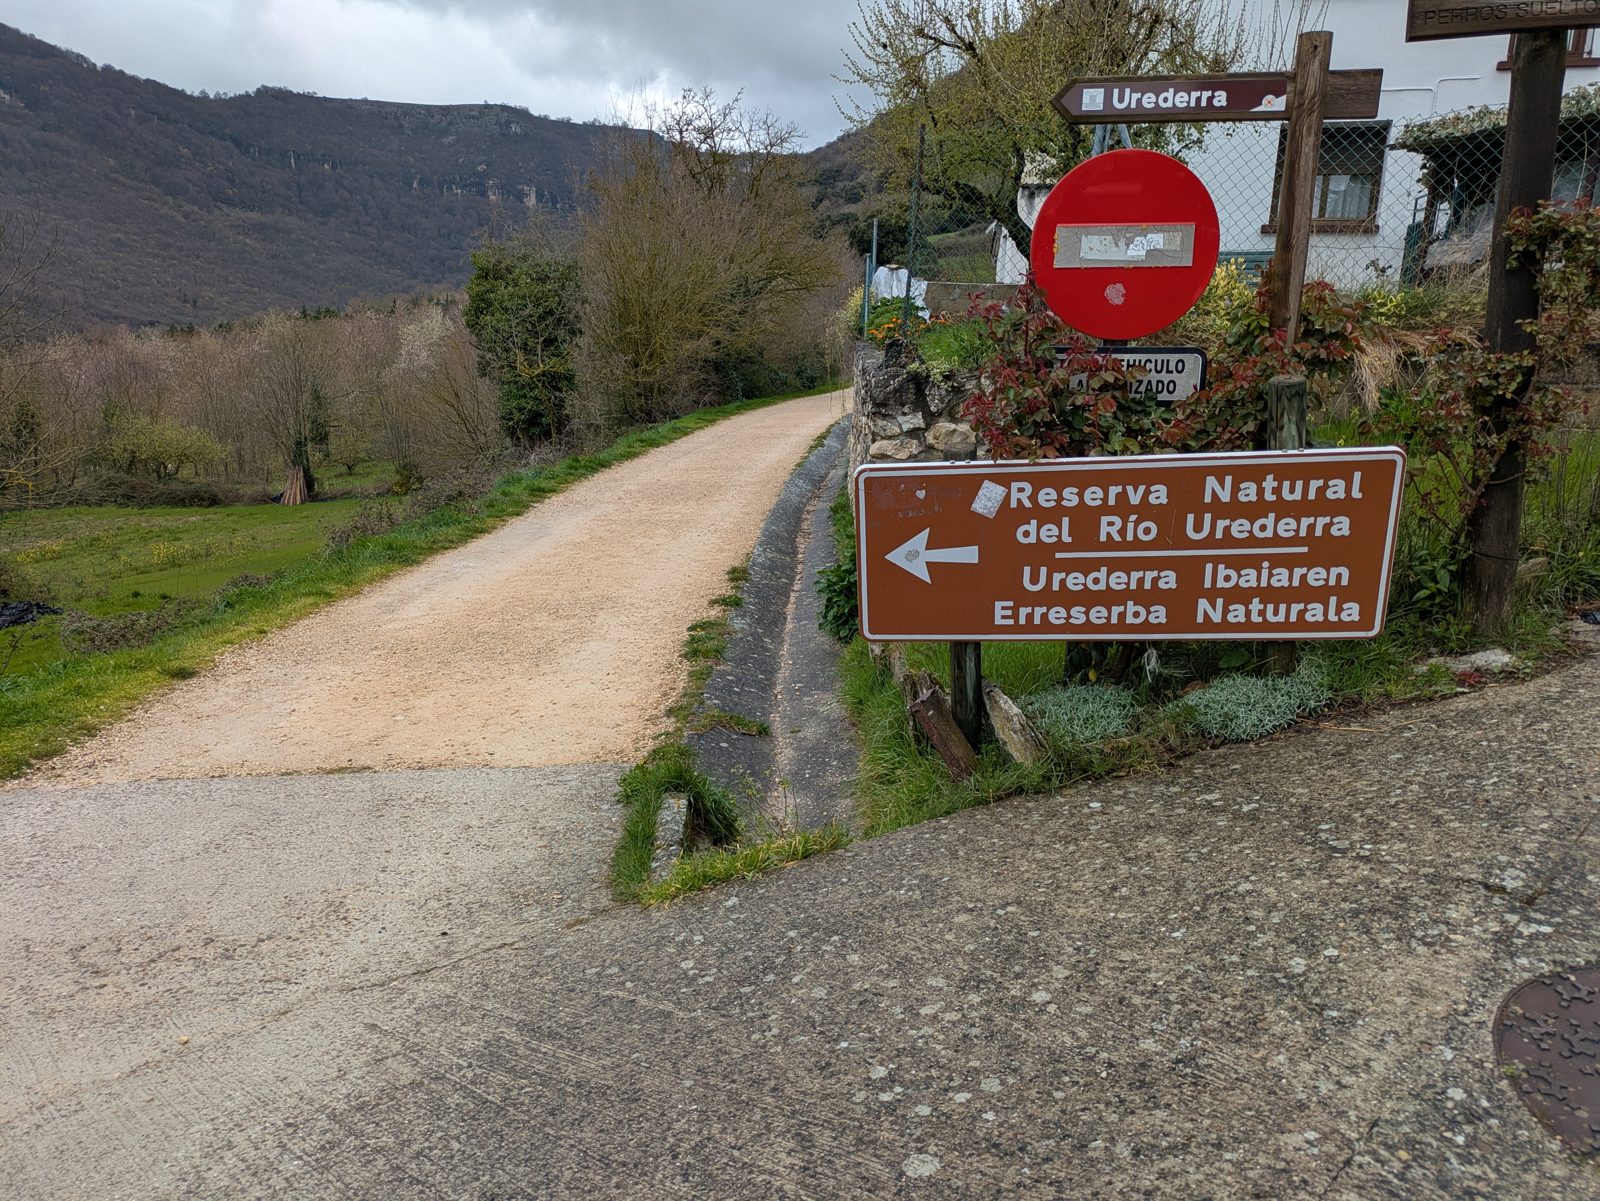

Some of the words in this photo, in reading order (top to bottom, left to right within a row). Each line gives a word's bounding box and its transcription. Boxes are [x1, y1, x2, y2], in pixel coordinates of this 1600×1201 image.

[1424, 4, 1508, 25] PERROS
[1516, 0, 1600, 17] SUELTO
[1112, 87, 1228, 110] Urederra
[1119, 358, 1186, 375] HCULO
[1010, 480, 1169, 508] Reserva
[1204, 471, 1363, 503] Natural
[1016, 516, 1073, 544] del
[1099, 513, 1158, 542] Río
[1185, 512, 1351, 540] Urederra
[1022, 566, 1178, 592] Urederra
[1203, 560, 1350, 589] Ibaiaren
[994, 599, 1168, 625] Erreserba
[1196, 596, 1361, 624] Naturala
